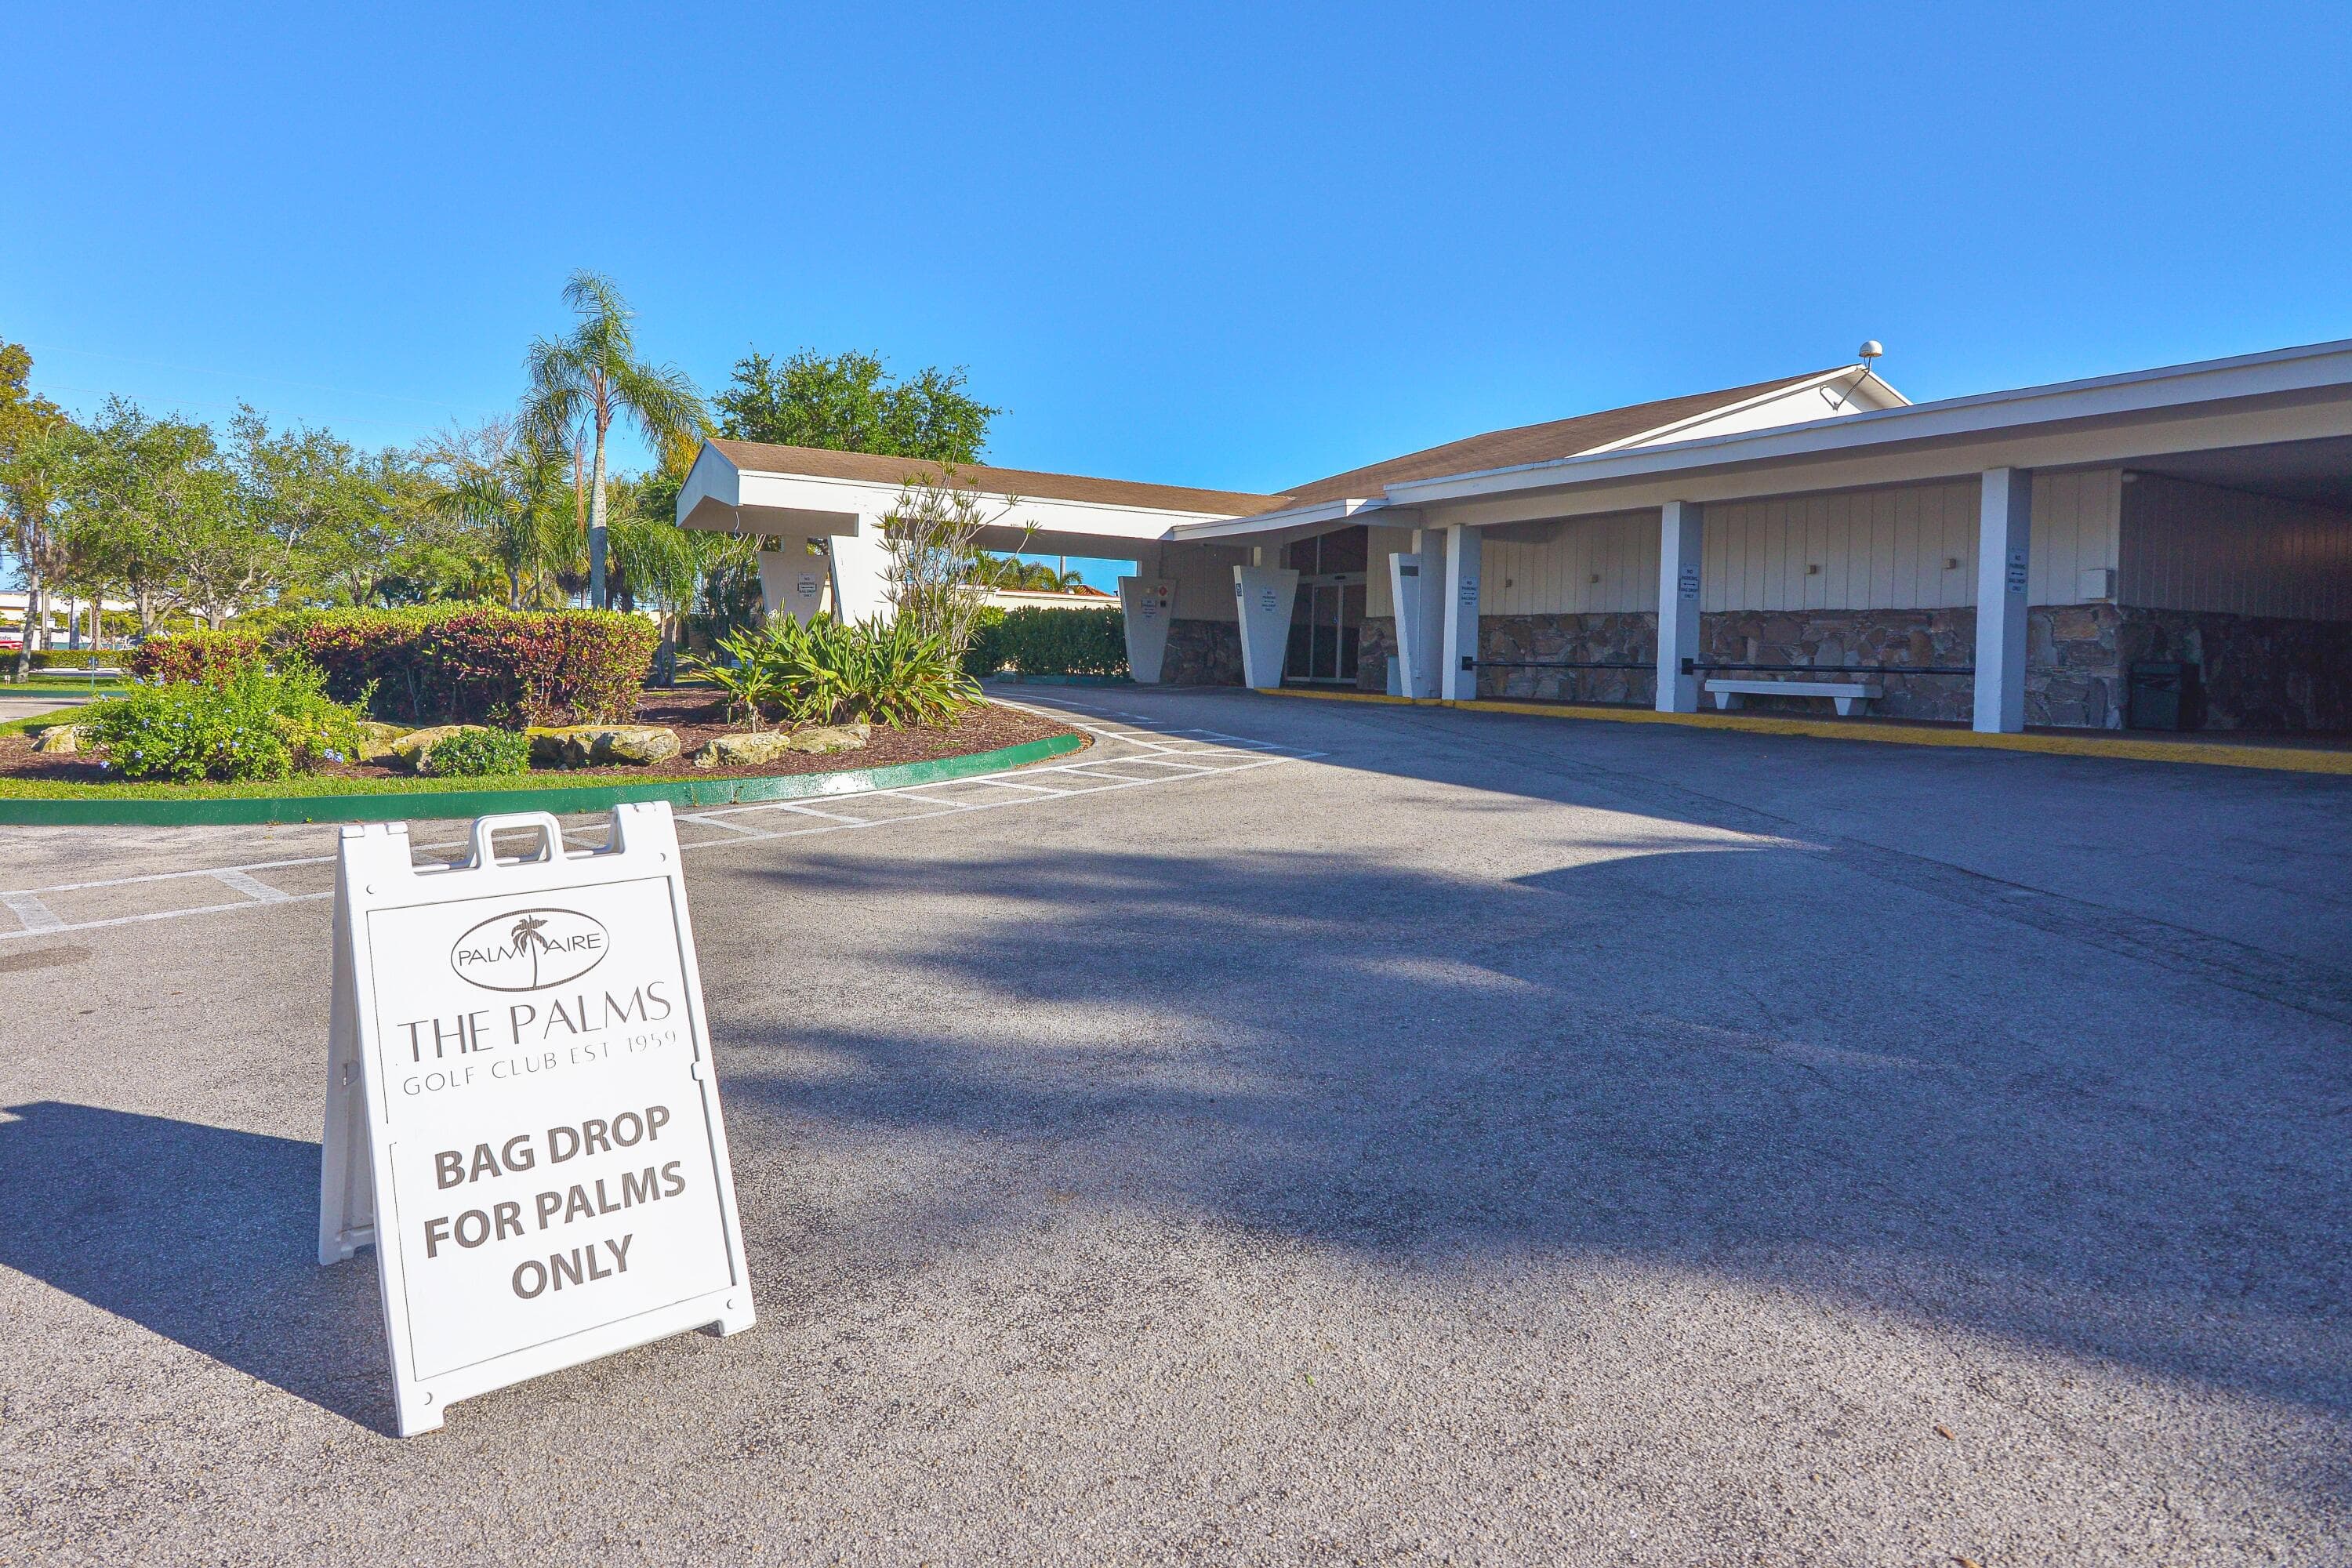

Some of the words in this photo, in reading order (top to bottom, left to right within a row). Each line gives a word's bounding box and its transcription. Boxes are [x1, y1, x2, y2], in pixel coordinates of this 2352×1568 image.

[459, 943, 524, 966] PALM
[543, 933, 601, 955] AIRE
[397, 1010, 494, 1062] THE
[510, 981, 671, 1044] PALMS
[403, 1066, 474, 1095] GOLF
[492, 1052, 557, 1079] CLUB
[571, 1042, 609, 1065] EST
[627, 1029, 677, 1053] 1959
[434, 1134, 535, 1190] BAG
[547, 1105, 670, 1164] DROP
[424, 1200, 525, 1259] FOR
[535, 1160, 686, 1230] PALMS
[512, 1233, 633, 1300] ONLY
